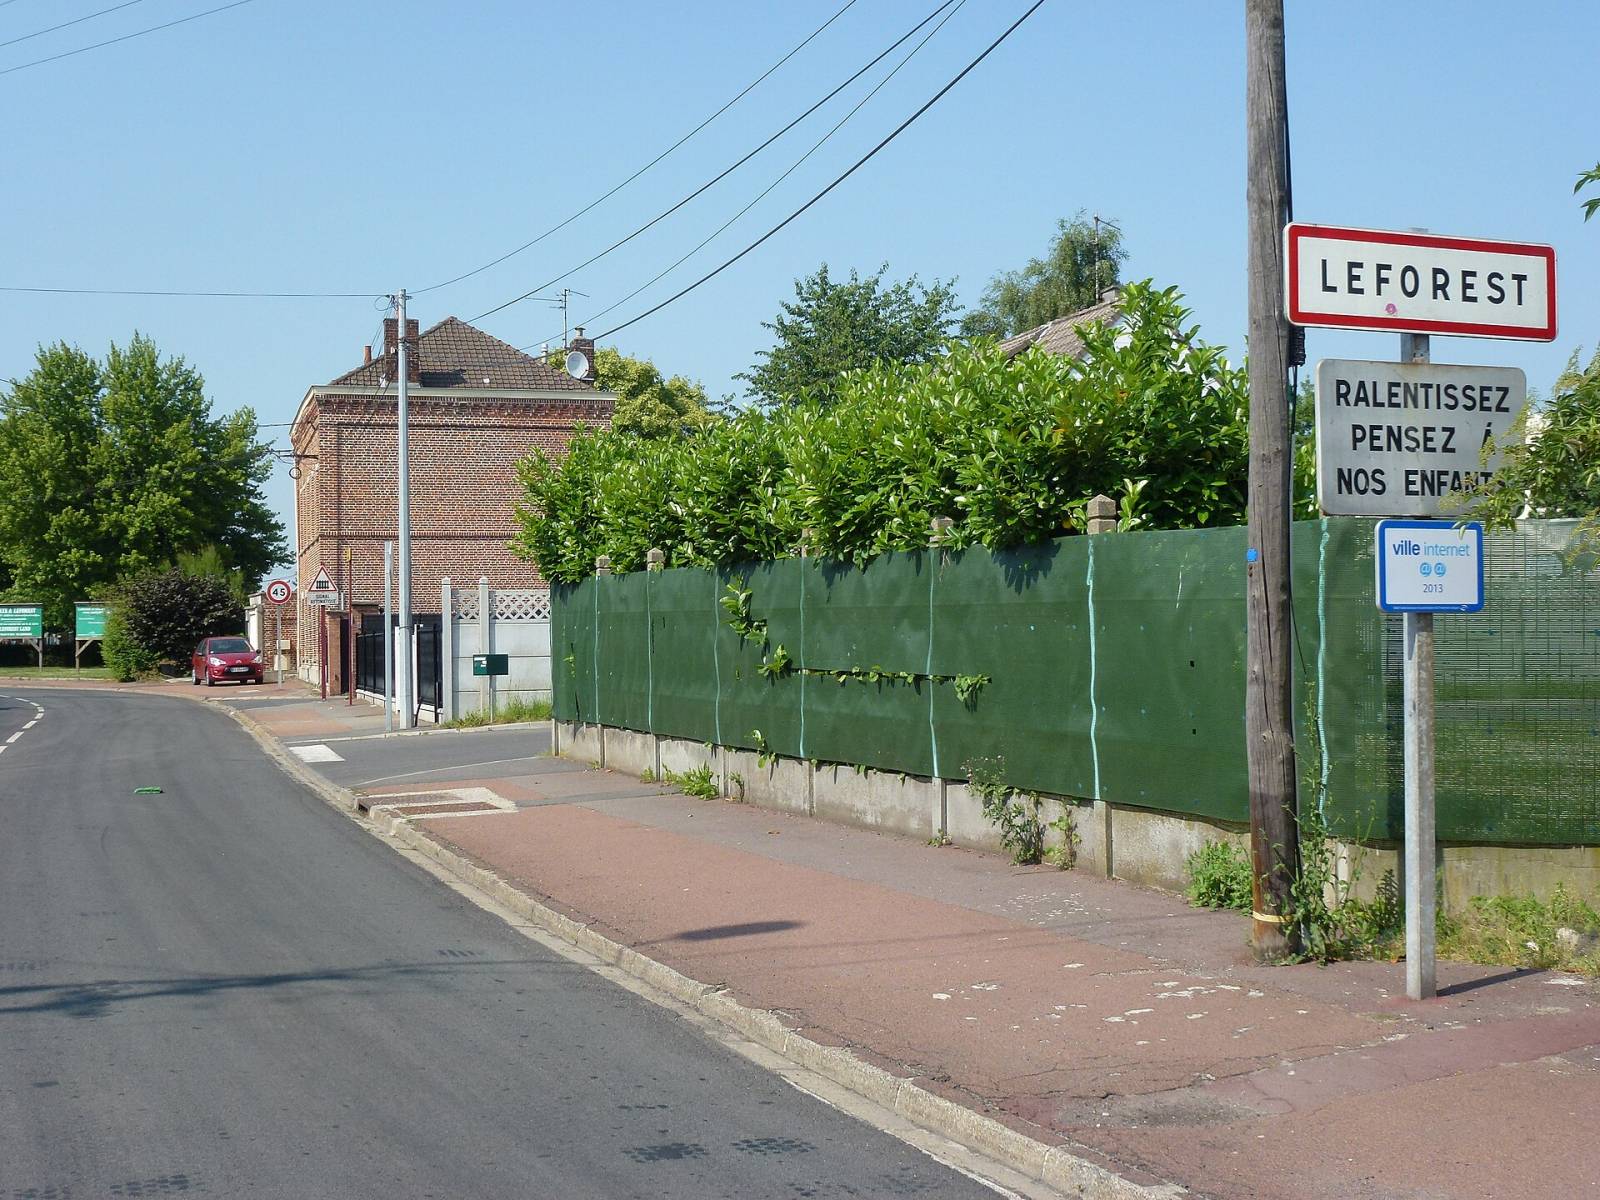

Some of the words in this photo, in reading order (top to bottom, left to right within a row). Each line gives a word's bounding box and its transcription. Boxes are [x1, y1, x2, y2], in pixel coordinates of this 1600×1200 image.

[1320, 258, 1528, 306] LEFOREST
[1335, 379, 1510, 413] RALENTISSEZ
[1351, 424, 1457, 454] PENSEZ
[1337, 467, 1387, 496] NOS
[1404, 469, 1506, 497] ENFANT
[1392, 540, 1421, 556] ville
[1423, 542, 1471, 557] internet
[272, 588, 286, 597] 45
[1423, 583, 1444, 593] 2013
